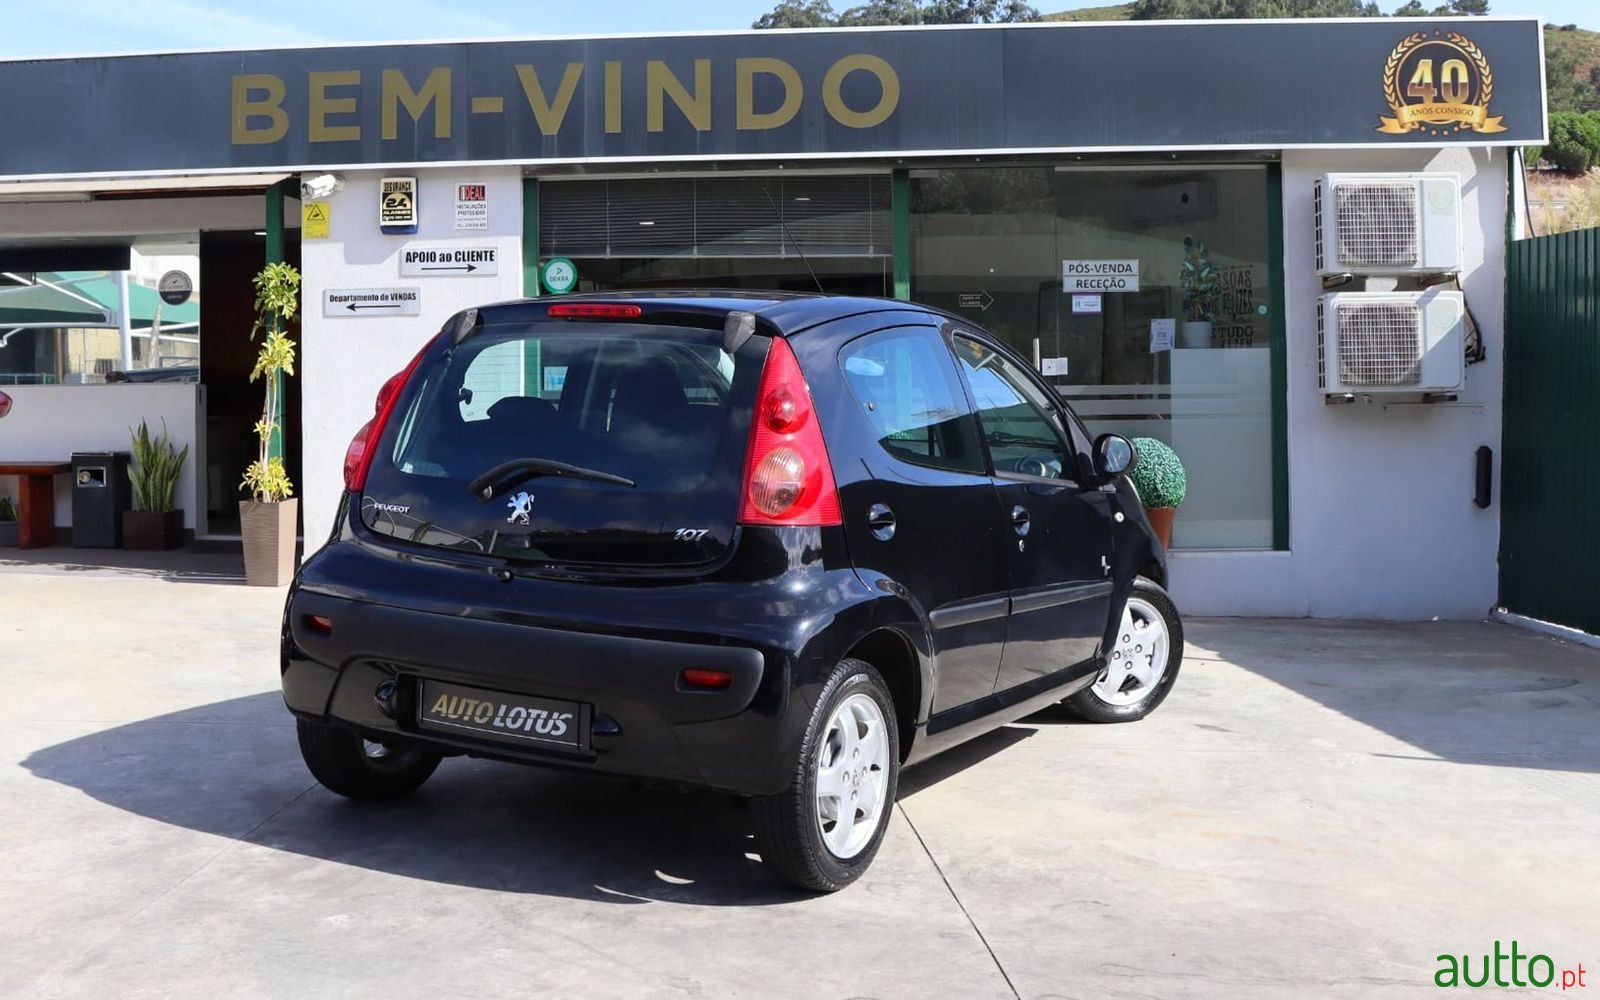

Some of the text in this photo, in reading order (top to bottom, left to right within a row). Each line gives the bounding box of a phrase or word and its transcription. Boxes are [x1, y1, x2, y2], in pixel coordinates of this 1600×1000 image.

[1407, 58, 1469, 105] 40
[231, 53, 901, 145] BEM-VINDO
[1410, 106, 1474, 117] ANOS CONSIGO
[460, 186, 485, 200] IDEAL
[405, 250, 495, 263] APOIO ao CLIENTE
[1068, 262, 1133, 274] PÓS-VENDA
[1076, 276, 1126, 290] RECEÇÃO
[329, 294, 379, 303] Departamento
[390, 293, 417, 301] VENDAS
[374, 503, 410, 513] PEUGEOT
[673, 527, 709, 541] 107
[431, 694, 573, 736] AUTO LOTUS
